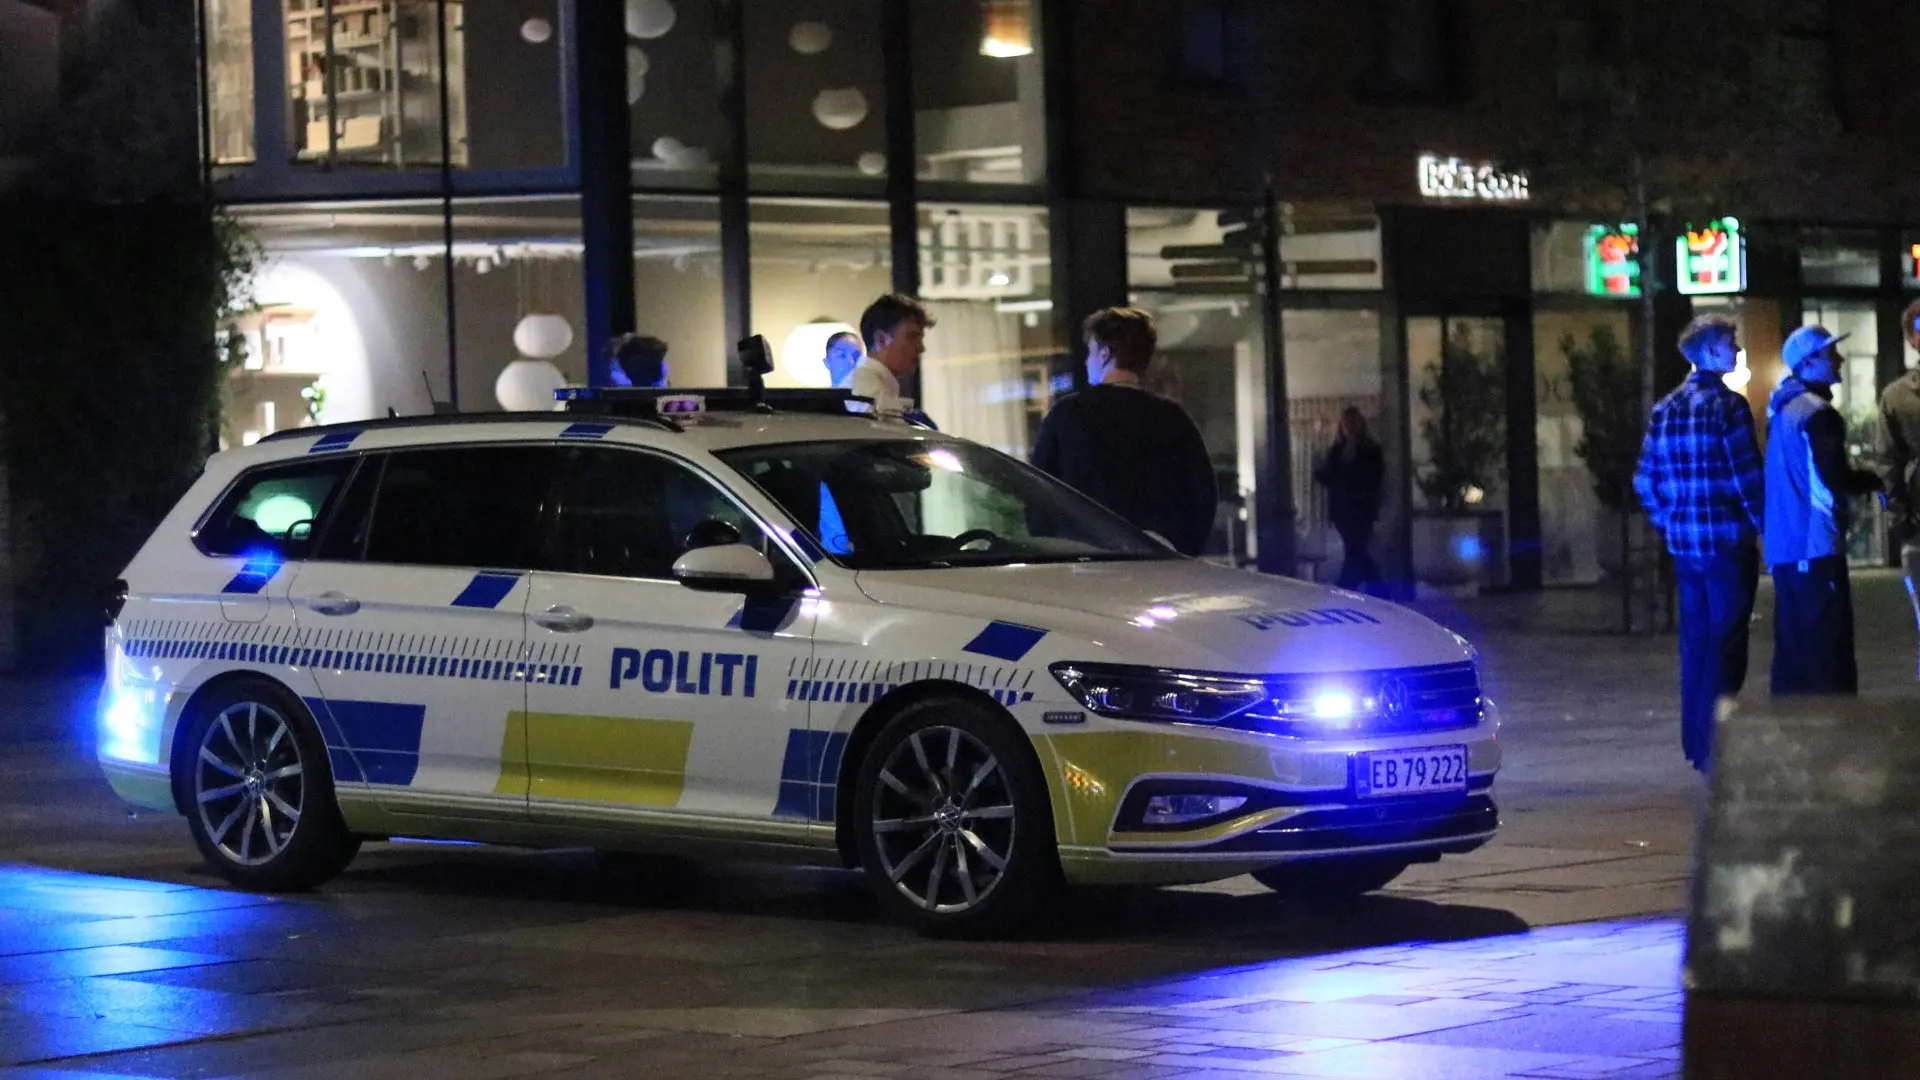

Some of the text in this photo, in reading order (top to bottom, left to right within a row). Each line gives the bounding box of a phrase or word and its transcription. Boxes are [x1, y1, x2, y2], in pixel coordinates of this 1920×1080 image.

[1234, 608, 1382, 631] POLITI
[610, 647, 758, 698] POLITI
[1372, 760, 1398, 789] EB
